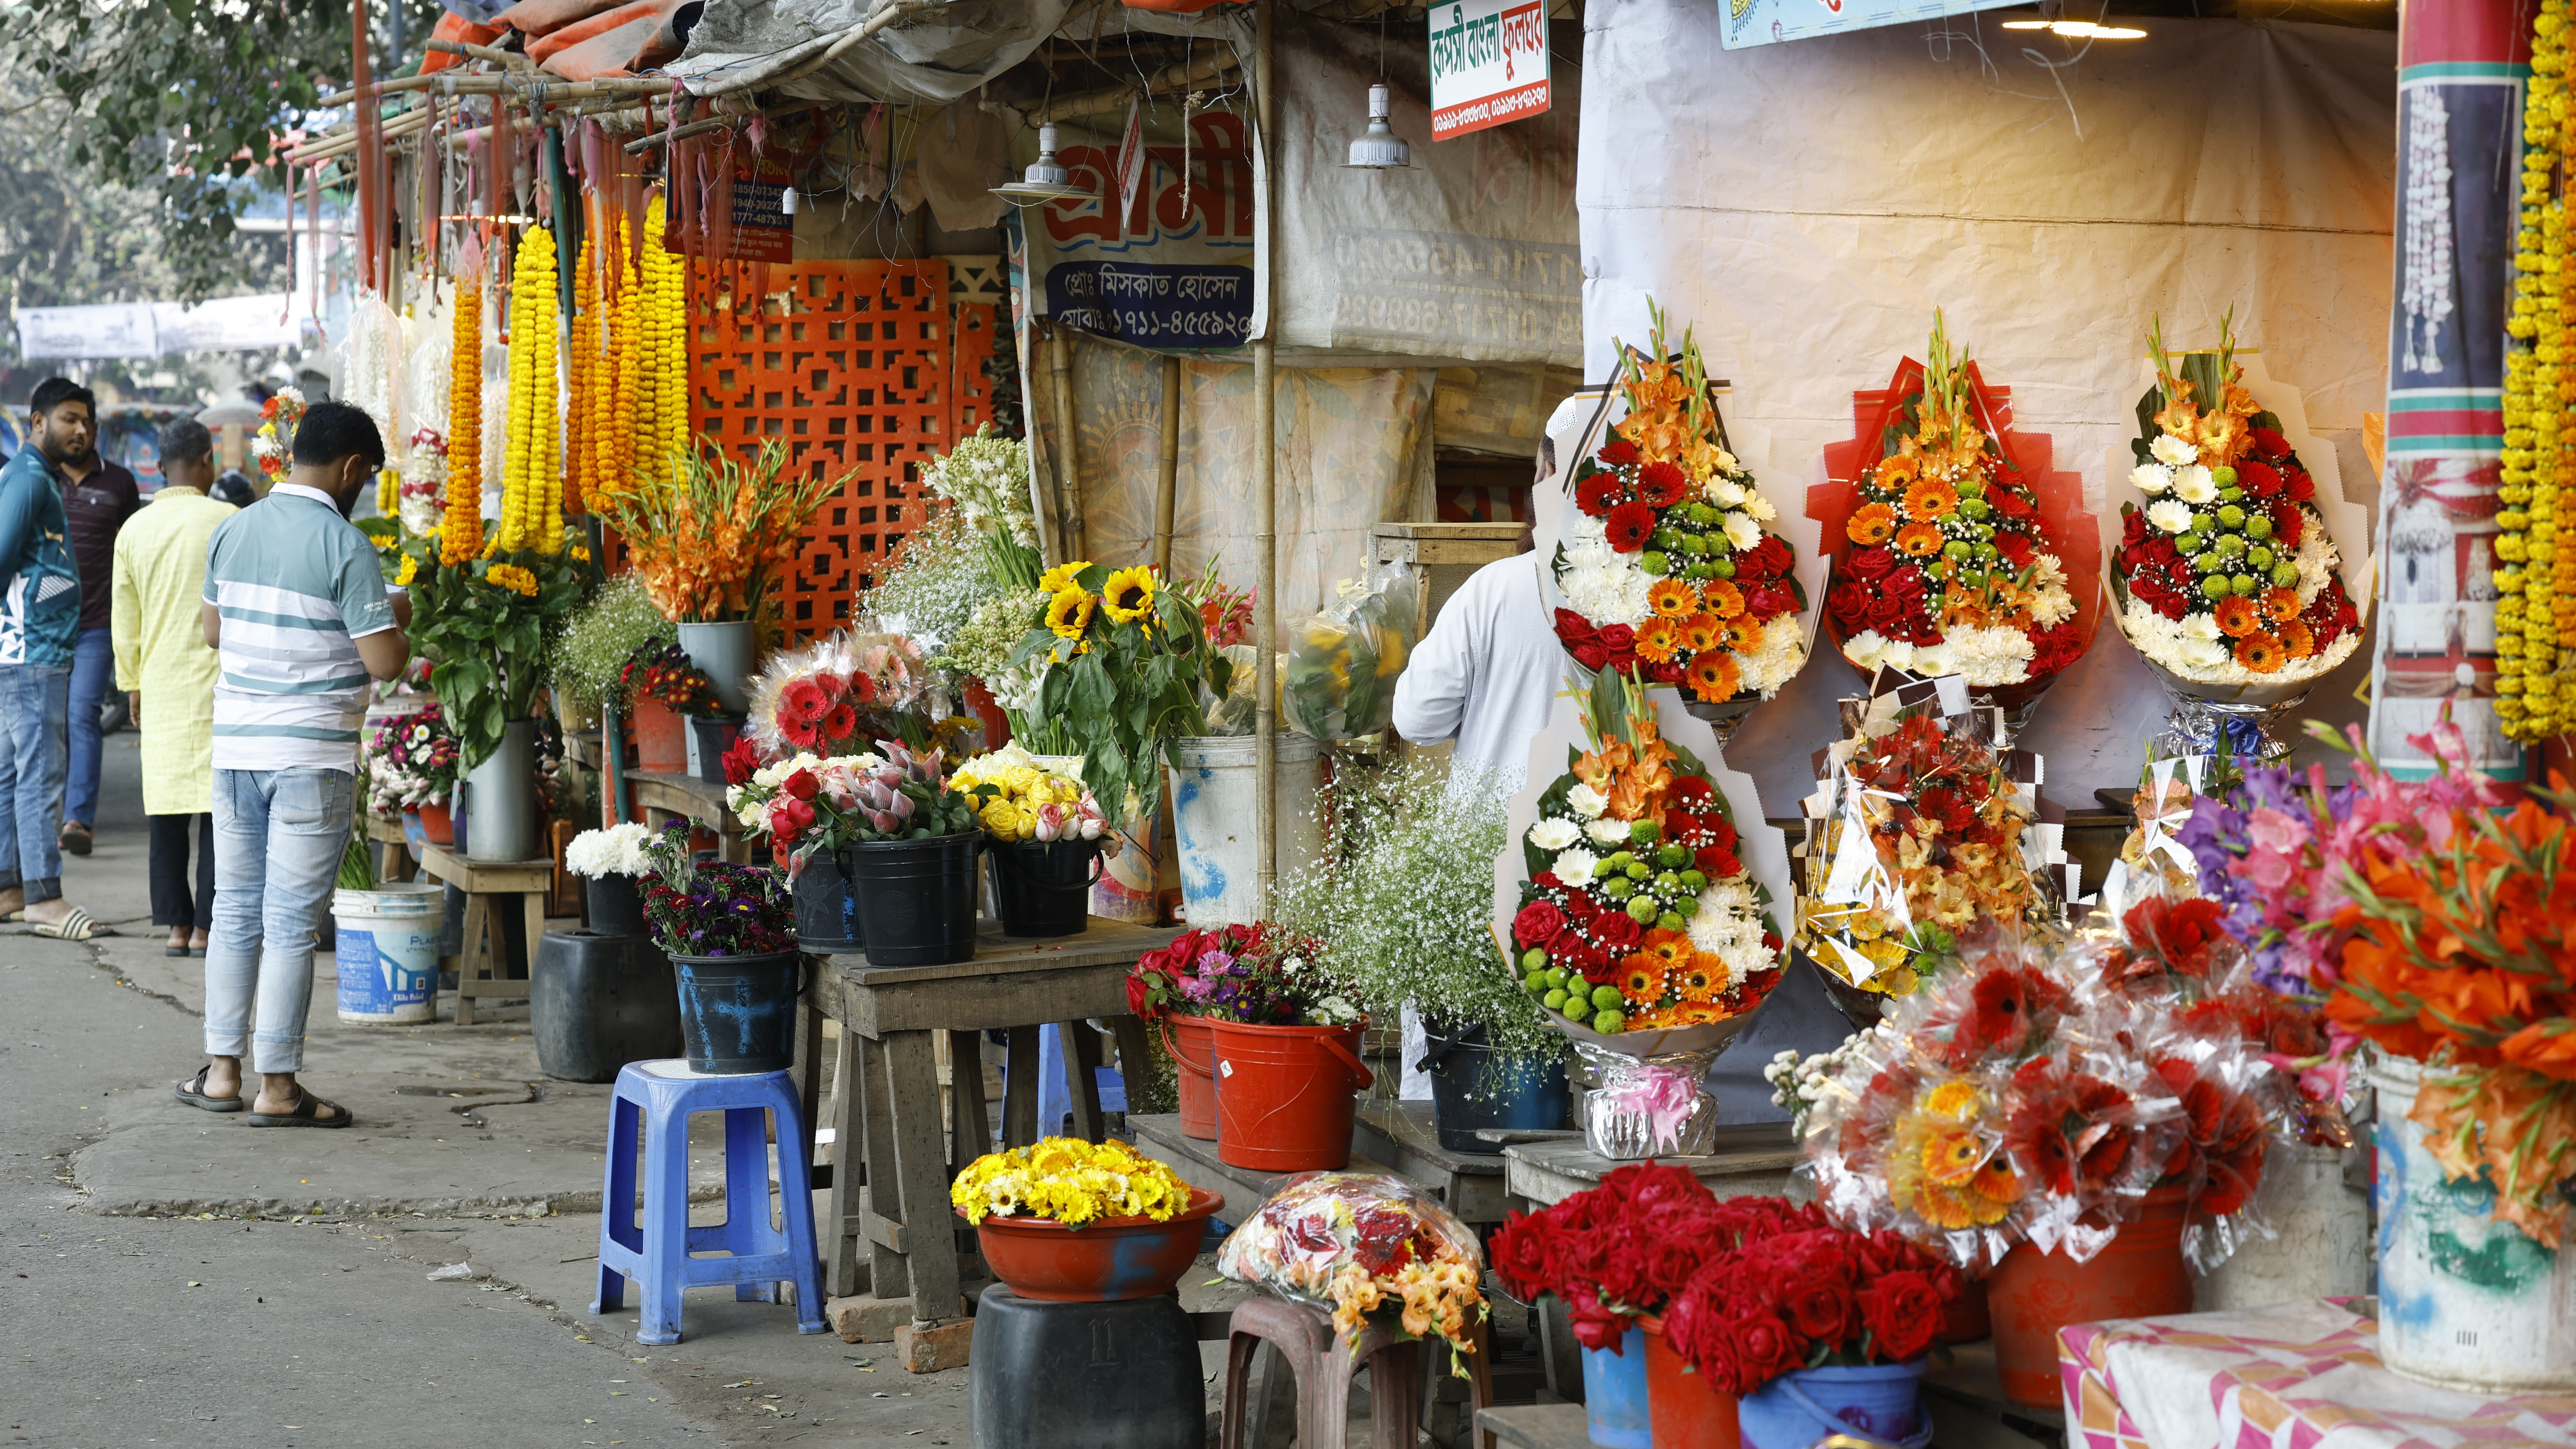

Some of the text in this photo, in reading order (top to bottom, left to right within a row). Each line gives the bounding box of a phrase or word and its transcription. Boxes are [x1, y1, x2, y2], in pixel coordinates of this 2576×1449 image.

[1432, 0, 1543, 85] রূপসী বাংলা ফুলঘর
[1121, 124, 1138, 184] WELCOME
[1098, 263, 1172, 299] মিসকাত
[1177, 272, 1241, 302] হোসেন
[363, 601, 382, 610] SAILING
